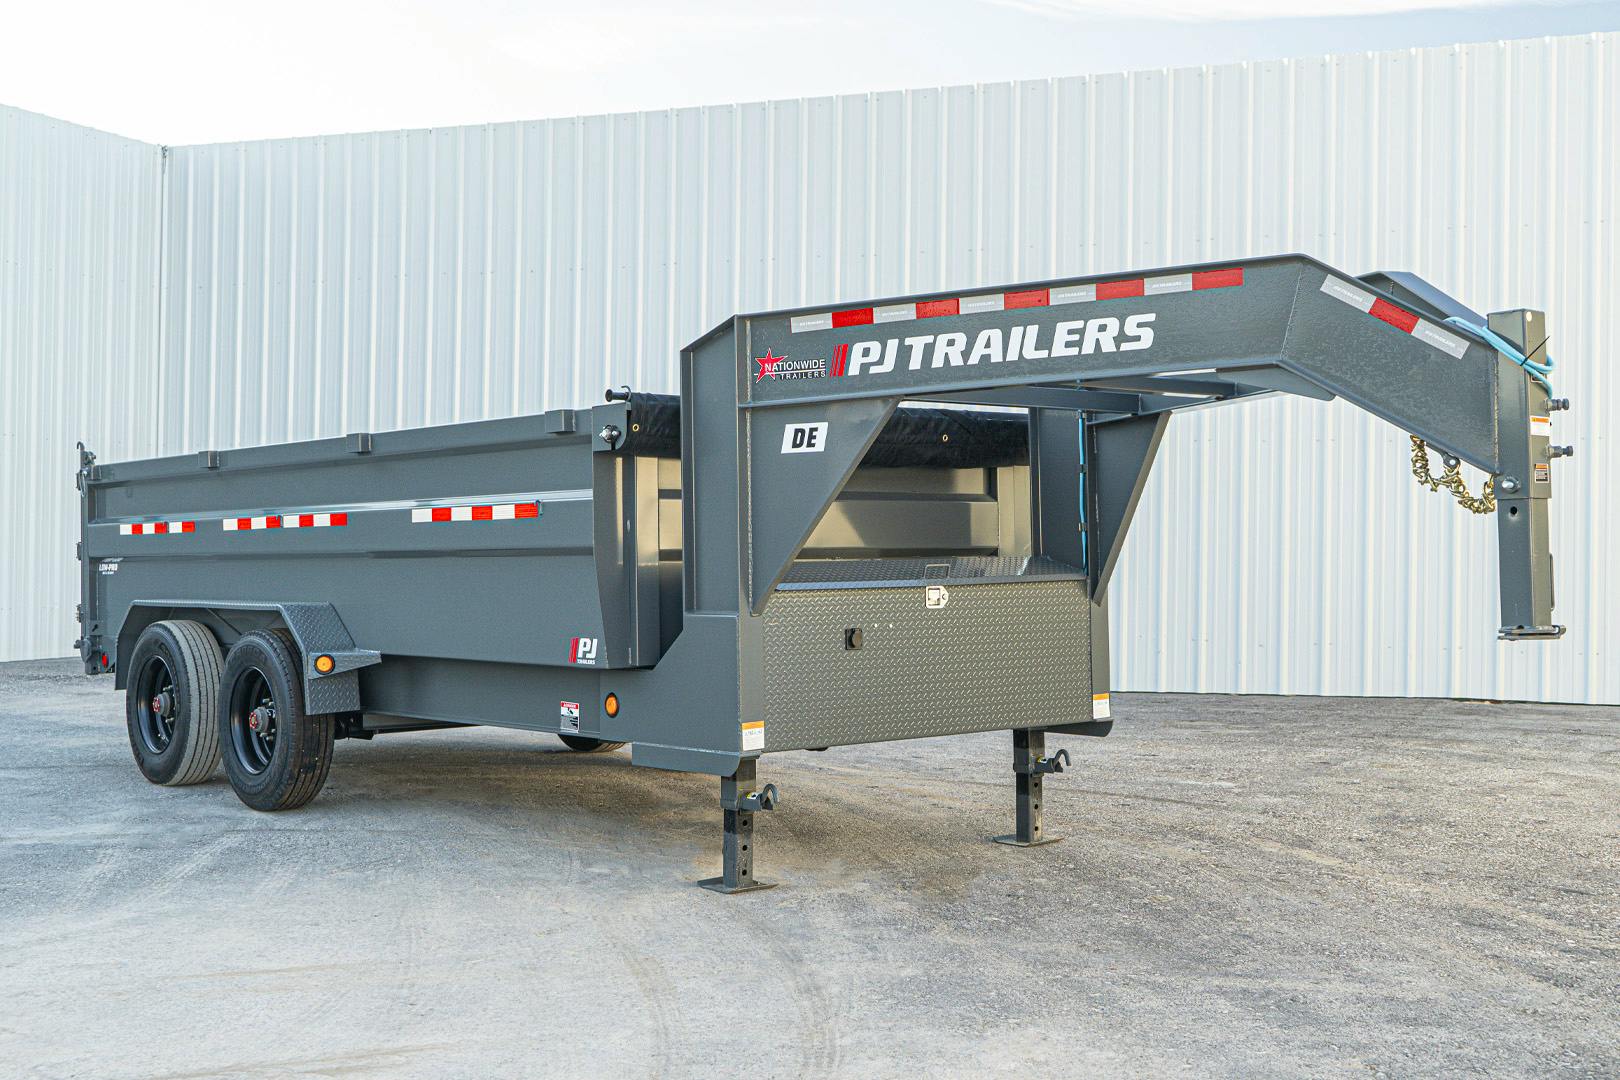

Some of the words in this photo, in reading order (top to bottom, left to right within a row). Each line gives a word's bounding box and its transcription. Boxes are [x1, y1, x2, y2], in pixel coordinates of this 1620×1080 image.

[848, 338, 899, 376] PJ
[904, 313, 1156, 371] TRAILERS
[765, 359, 825, 371] NATIONWIDE
[781, 371, 826, 379] TRAILERS
[791, 427, 819, 449] DE
[577, 637, 598, 658] PJ
